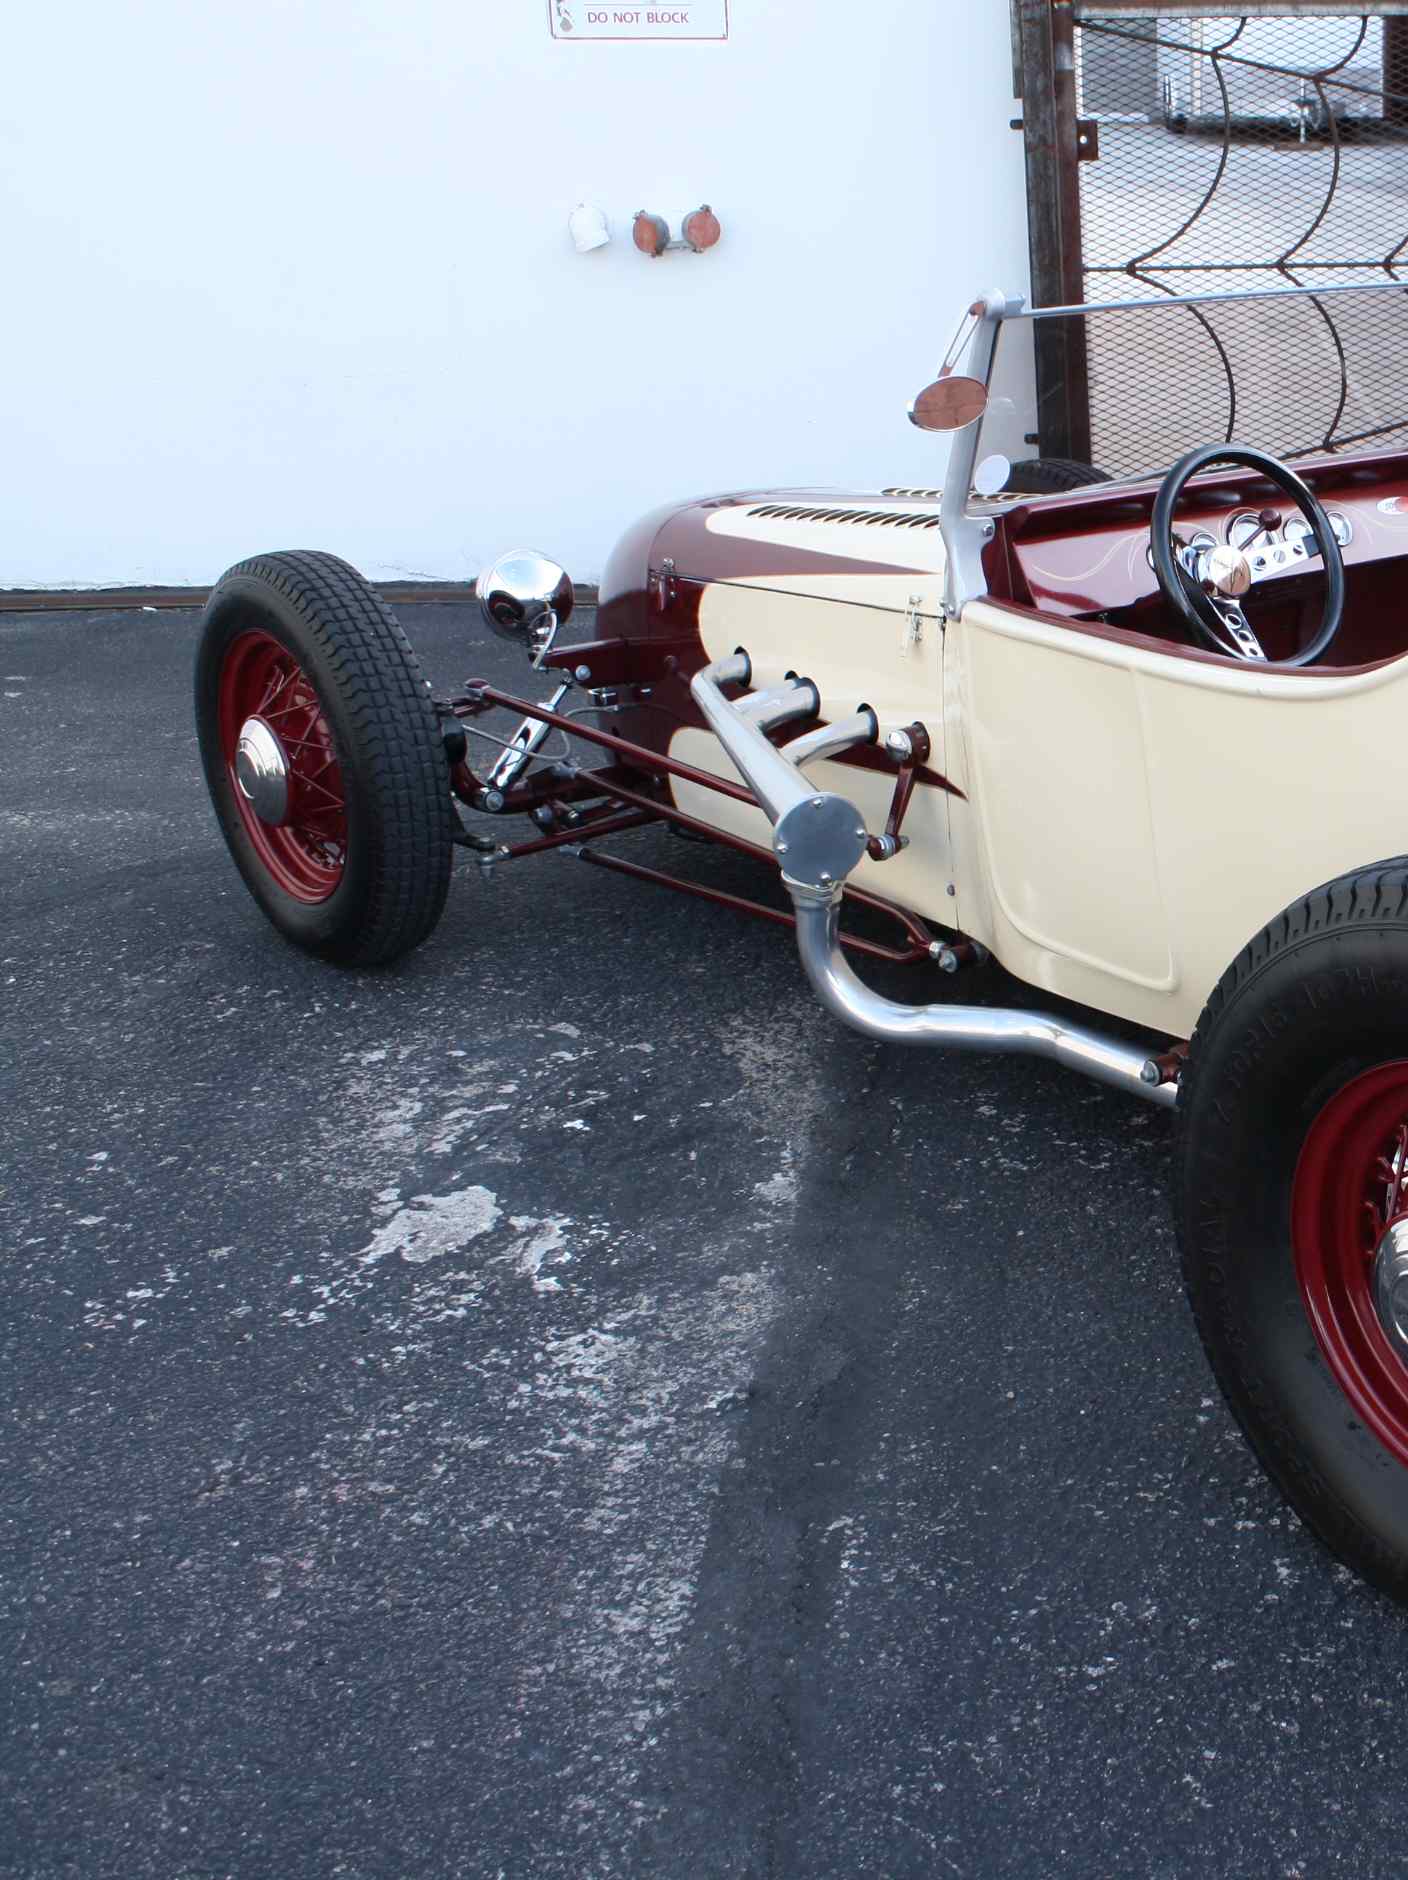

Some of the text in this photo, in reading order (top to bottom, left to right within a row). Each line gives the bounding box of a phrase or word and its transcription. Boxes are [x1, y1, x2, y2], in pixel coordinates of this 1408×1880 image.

[587, 12, 689, 24] DO NOT BLOCK
